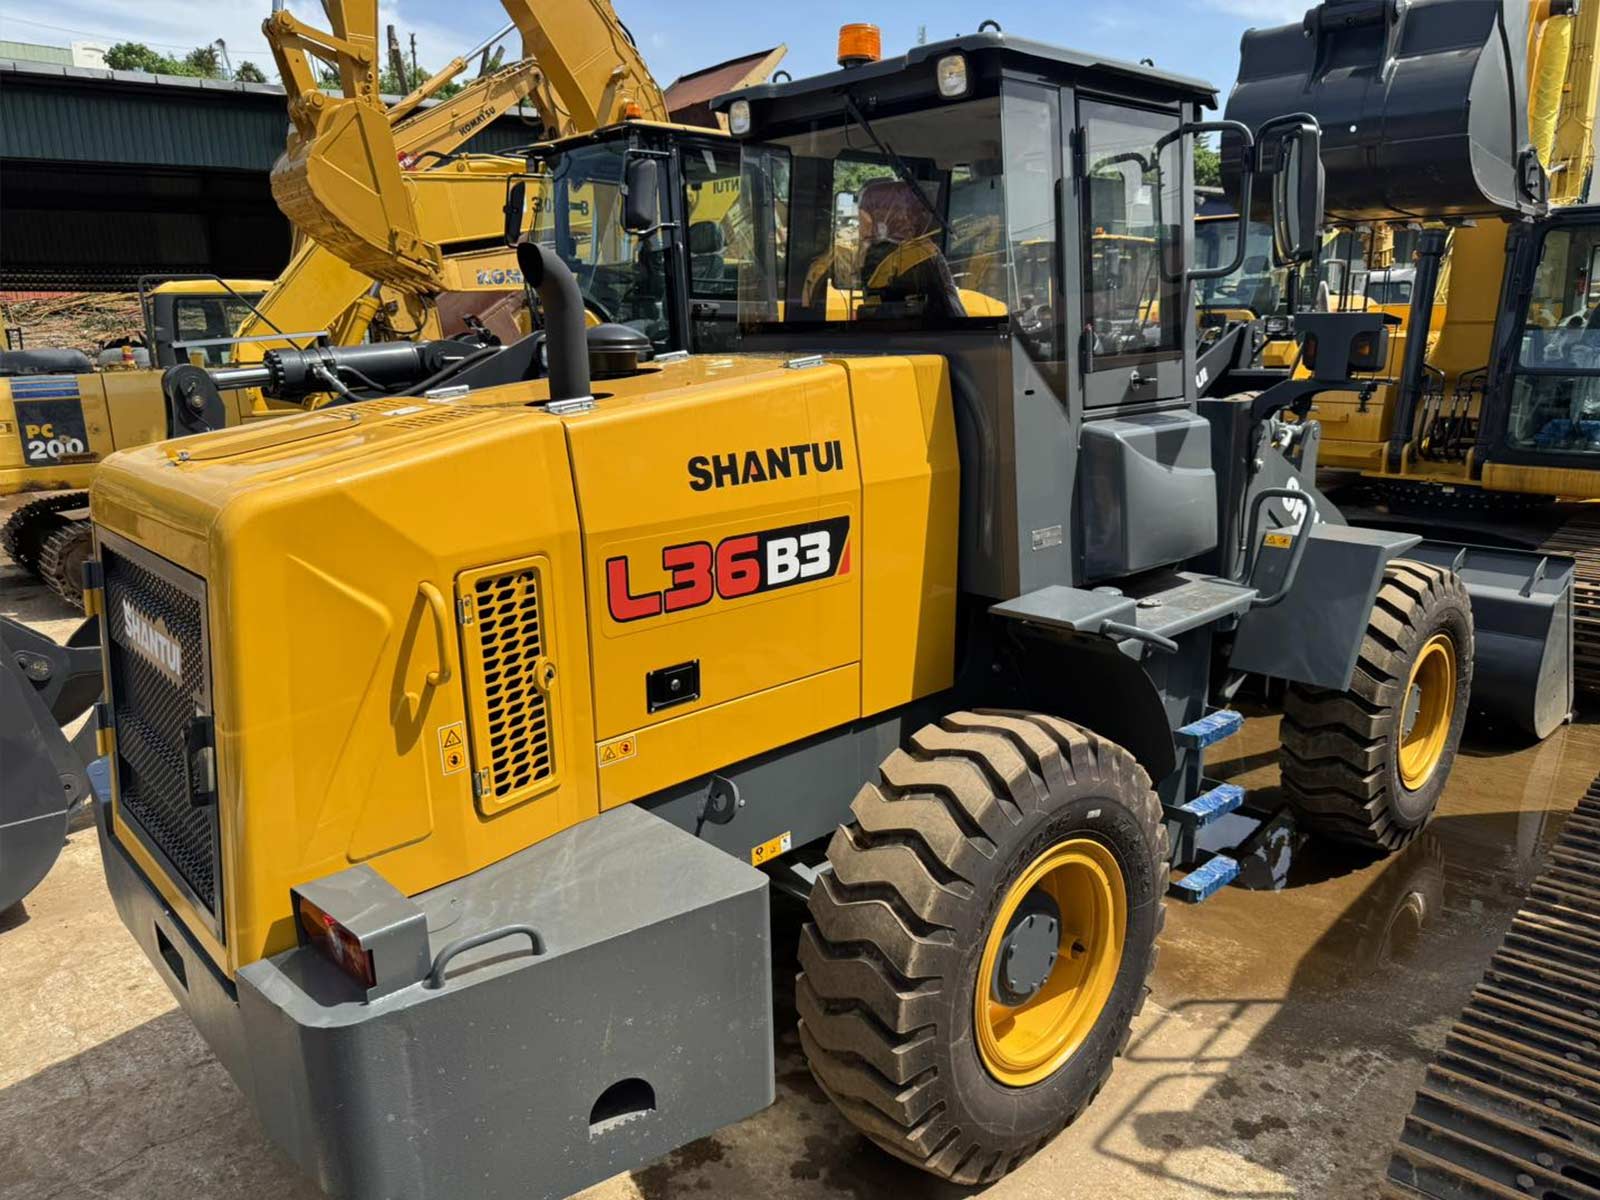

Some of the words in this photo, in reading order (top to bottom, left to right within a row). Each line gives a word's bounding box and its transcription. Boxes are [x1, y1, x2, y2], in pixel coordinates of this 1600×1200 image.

[458, 106, 497, 136] KOMATSU
[25, 423, 55, 440] PC
[28, 438, 84, 460] 200
[687, 440, 844, 492] SHANTUI
[605, 530, 832, 623] L36B3
[122, 597, 182, 676] SHANTUI
